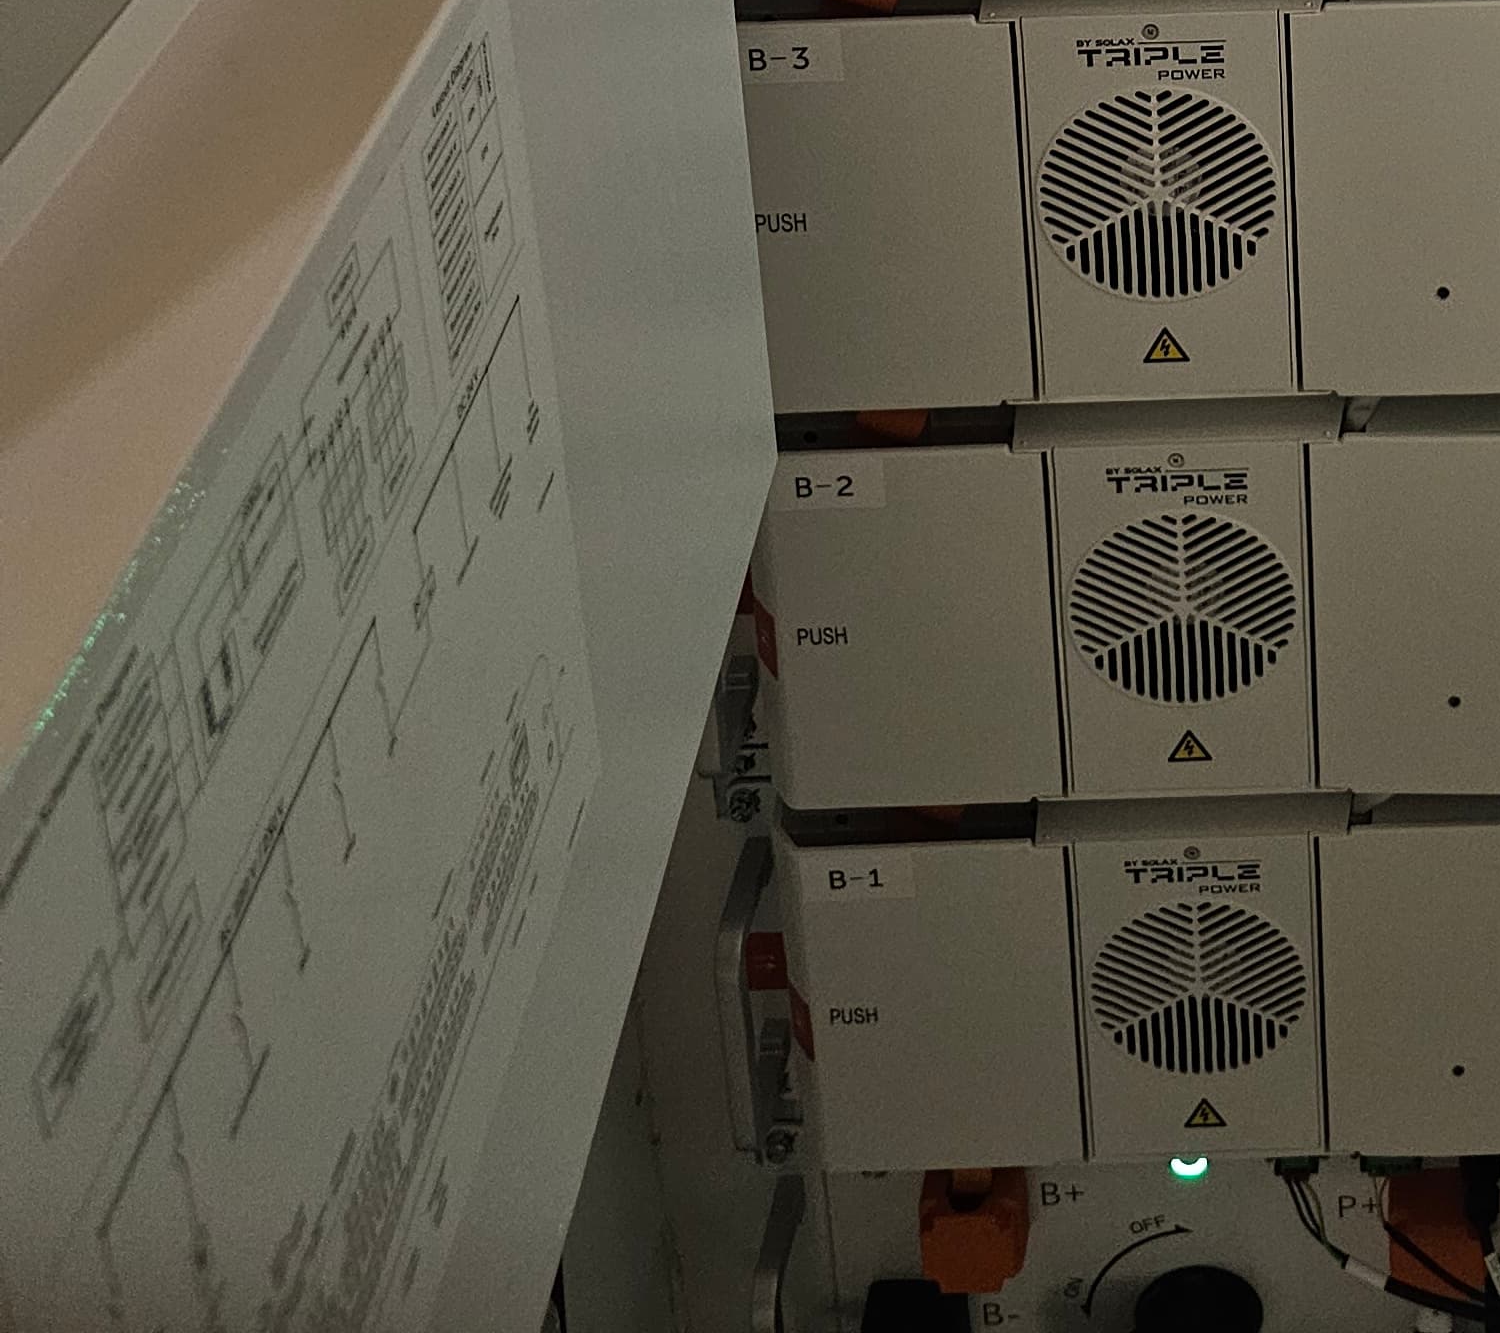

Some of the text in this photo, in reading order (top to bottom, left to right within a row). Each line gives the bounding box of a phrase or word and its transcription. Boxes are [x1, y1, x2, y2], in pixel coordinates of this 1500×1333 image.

[1076, 38, 1135, 47] BY SOLAX
[748, 46, 810, 71] B-3
[1077, 45, 1225, 67] TRIPLE
[1157, 68, 1226, 81] POWER
[754, 213, 807, 233] PUSH
[1105, 466, 1162, 475] BY SOLAX
[795, 475, 854, 498] B-2
[1107, 473, 1248, 494] TRIPLE
[1183, 494, 1248, 505] POWER
[797, 626, 848, 646] PUSH
[828, 868, 884, 890] B-1
[1125, 864, 1261, 883] TRIPLE
[1198, 883, 1261, 894] POWER
[830, 1006, 879, 1026] PUSH
[1040, 1182, 1085, 1206] B+
[1338, 1195, 1377, 1218] P+
[1129, 1214, 1165, 1234] OFF
[983, 1302, 1020, 1326] B-
